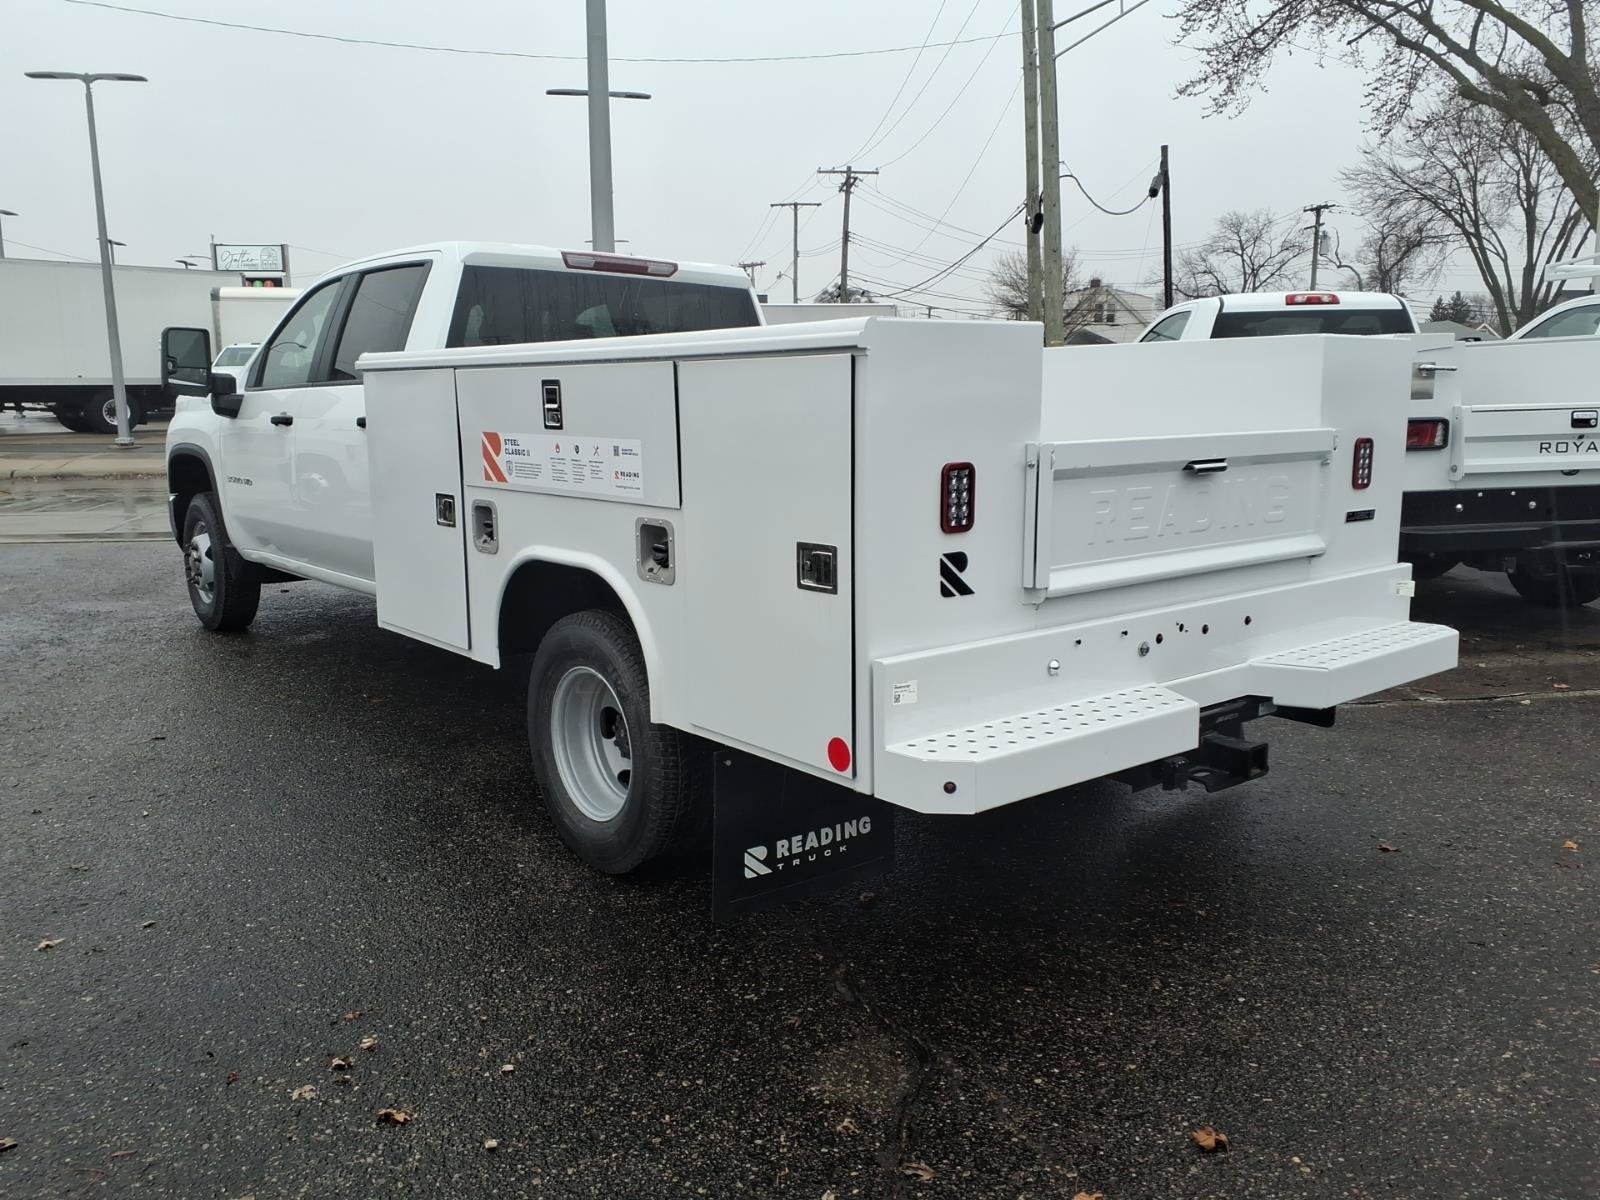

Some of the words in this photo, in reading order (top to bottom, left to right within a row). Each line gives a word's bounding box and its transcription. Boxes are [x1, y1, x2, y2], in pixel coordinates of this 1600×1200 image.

[504, 439, 520, 447] STEEL
[505, 448, 526, 456] CLASSIC
[1539, 441, 1599, 454] ROYA
[1087, 476, 1289, 545] READING
[776, 816, 872, 859] READING
[777, 845, 848, 871] TRUCK
